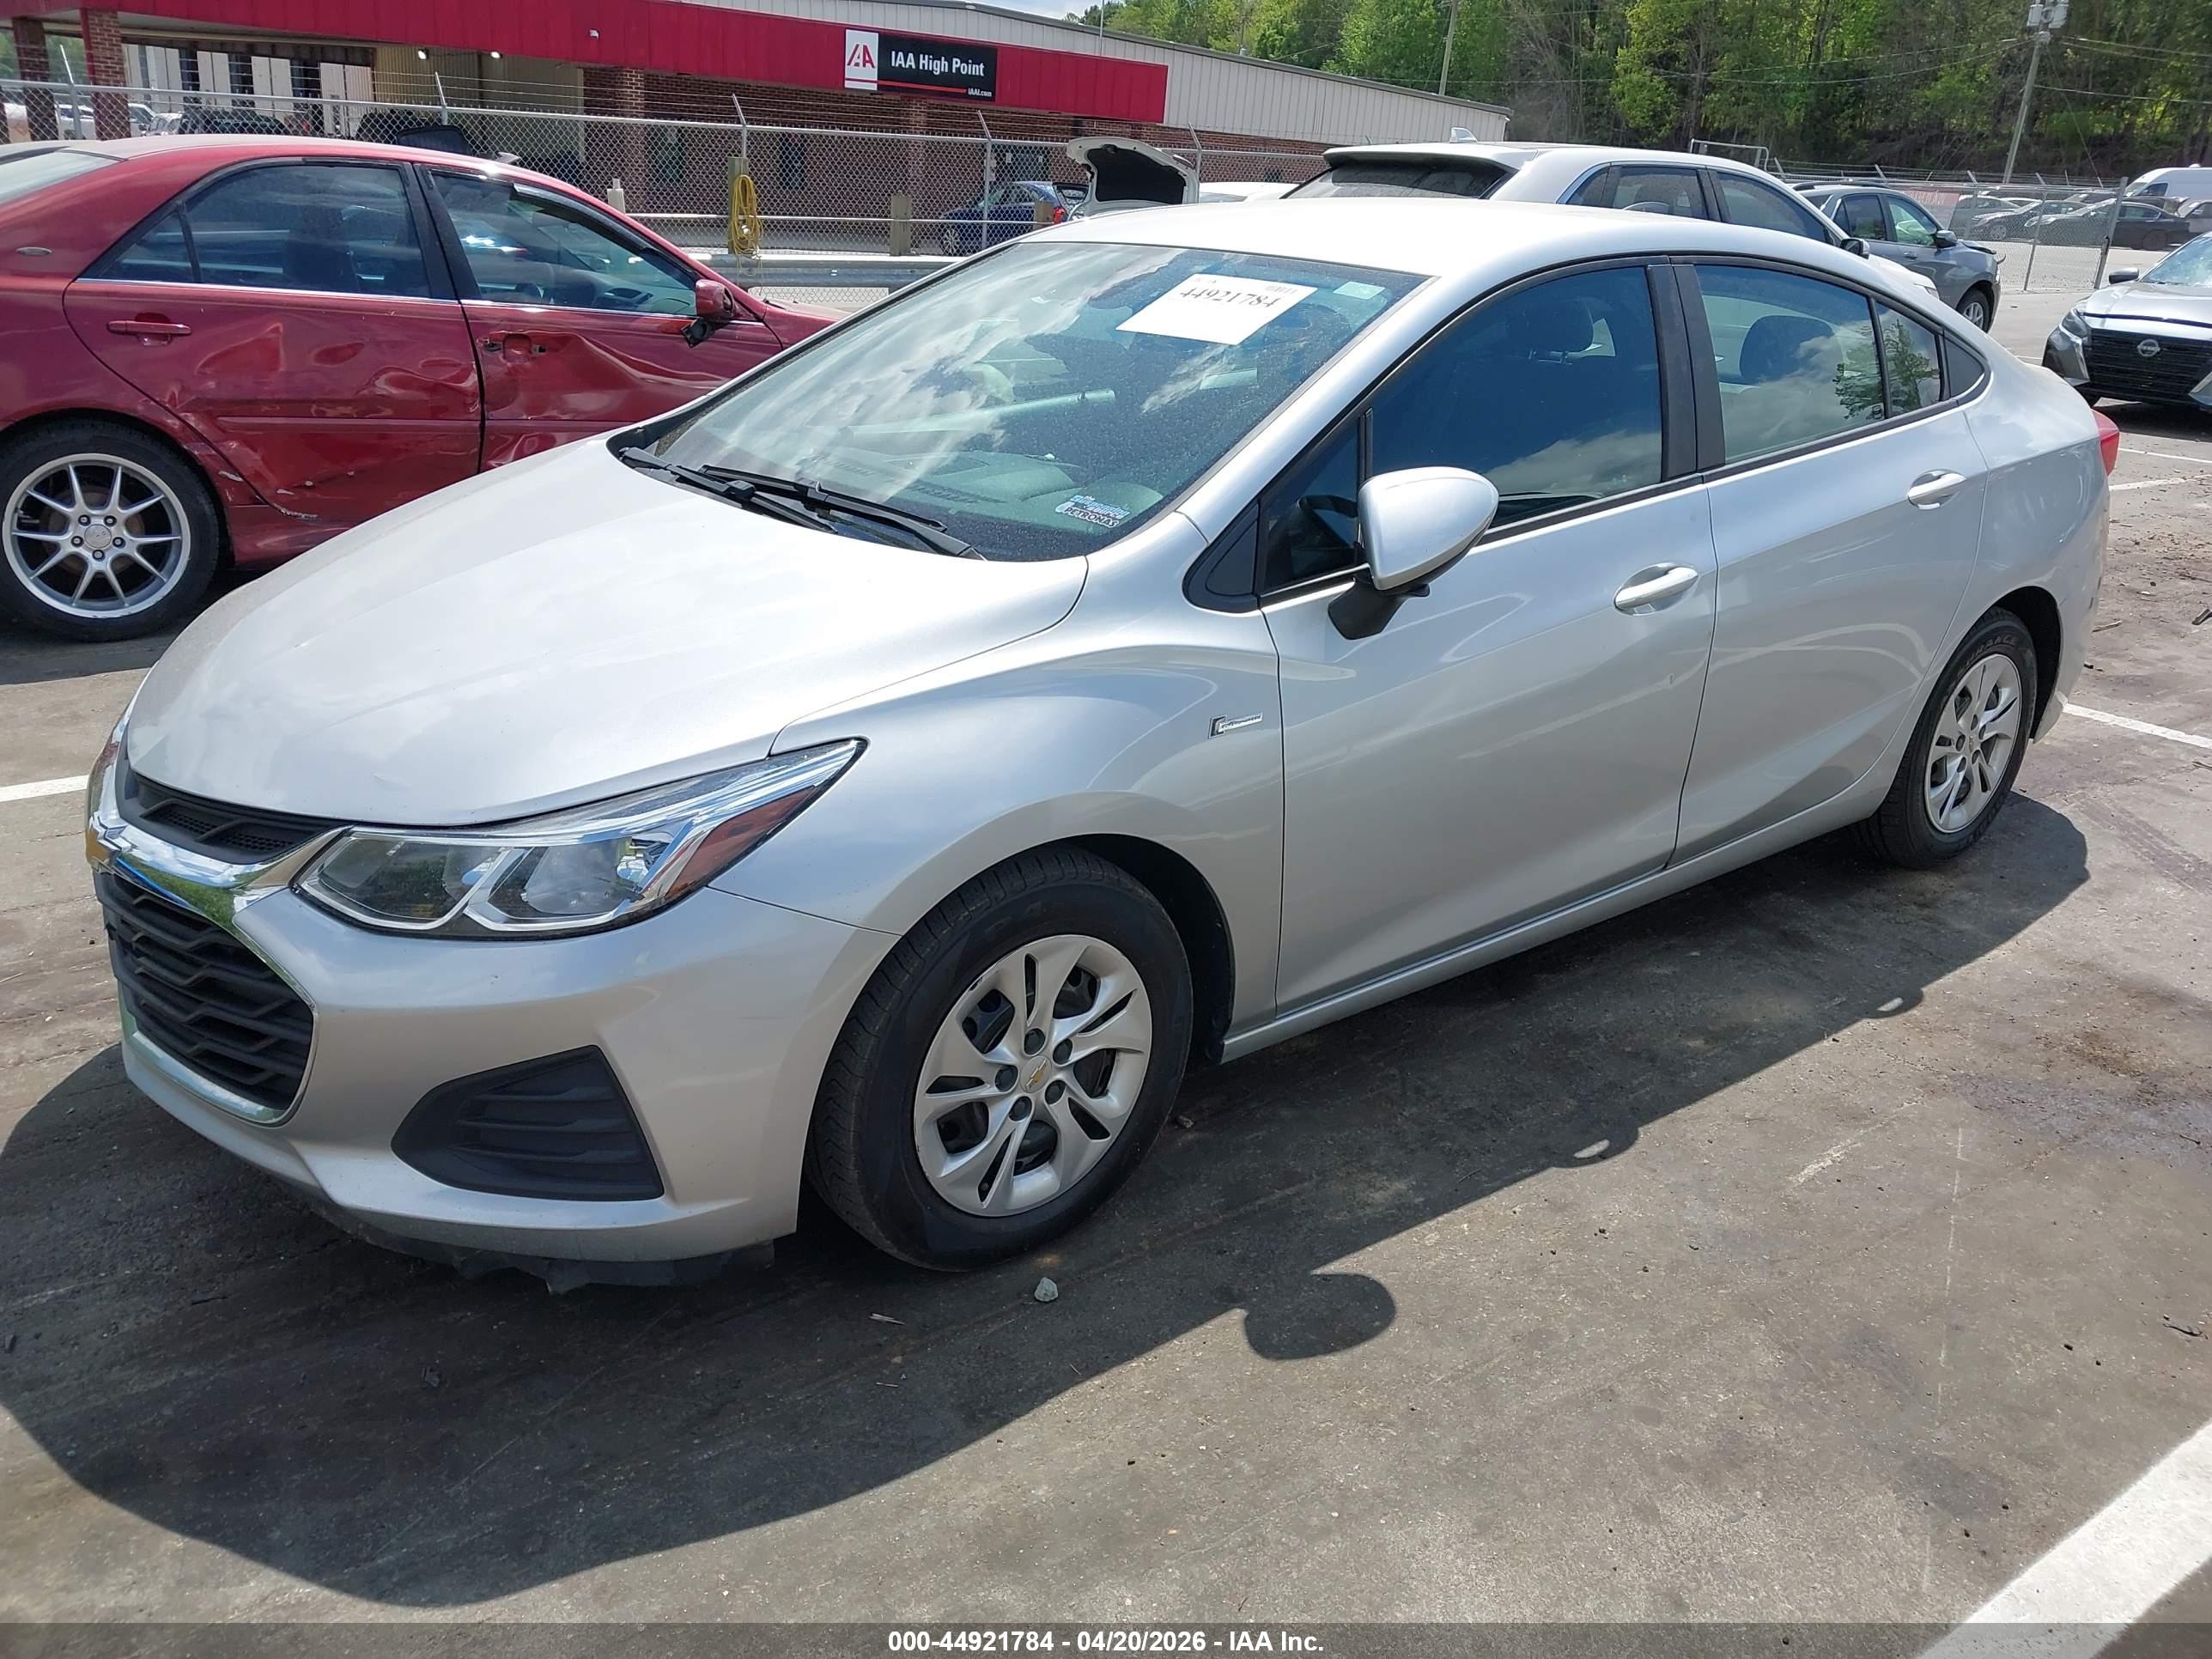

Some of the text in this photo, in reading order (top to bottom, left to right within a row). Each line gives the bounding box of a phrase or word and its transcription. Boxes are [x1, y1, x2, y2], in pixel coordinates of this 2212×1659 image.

[890, 50, 985, 76] IAA High Point
[1179, 286, 1281, 307] 44921784
[1064, 506, 1118, 527] PETRONAS
